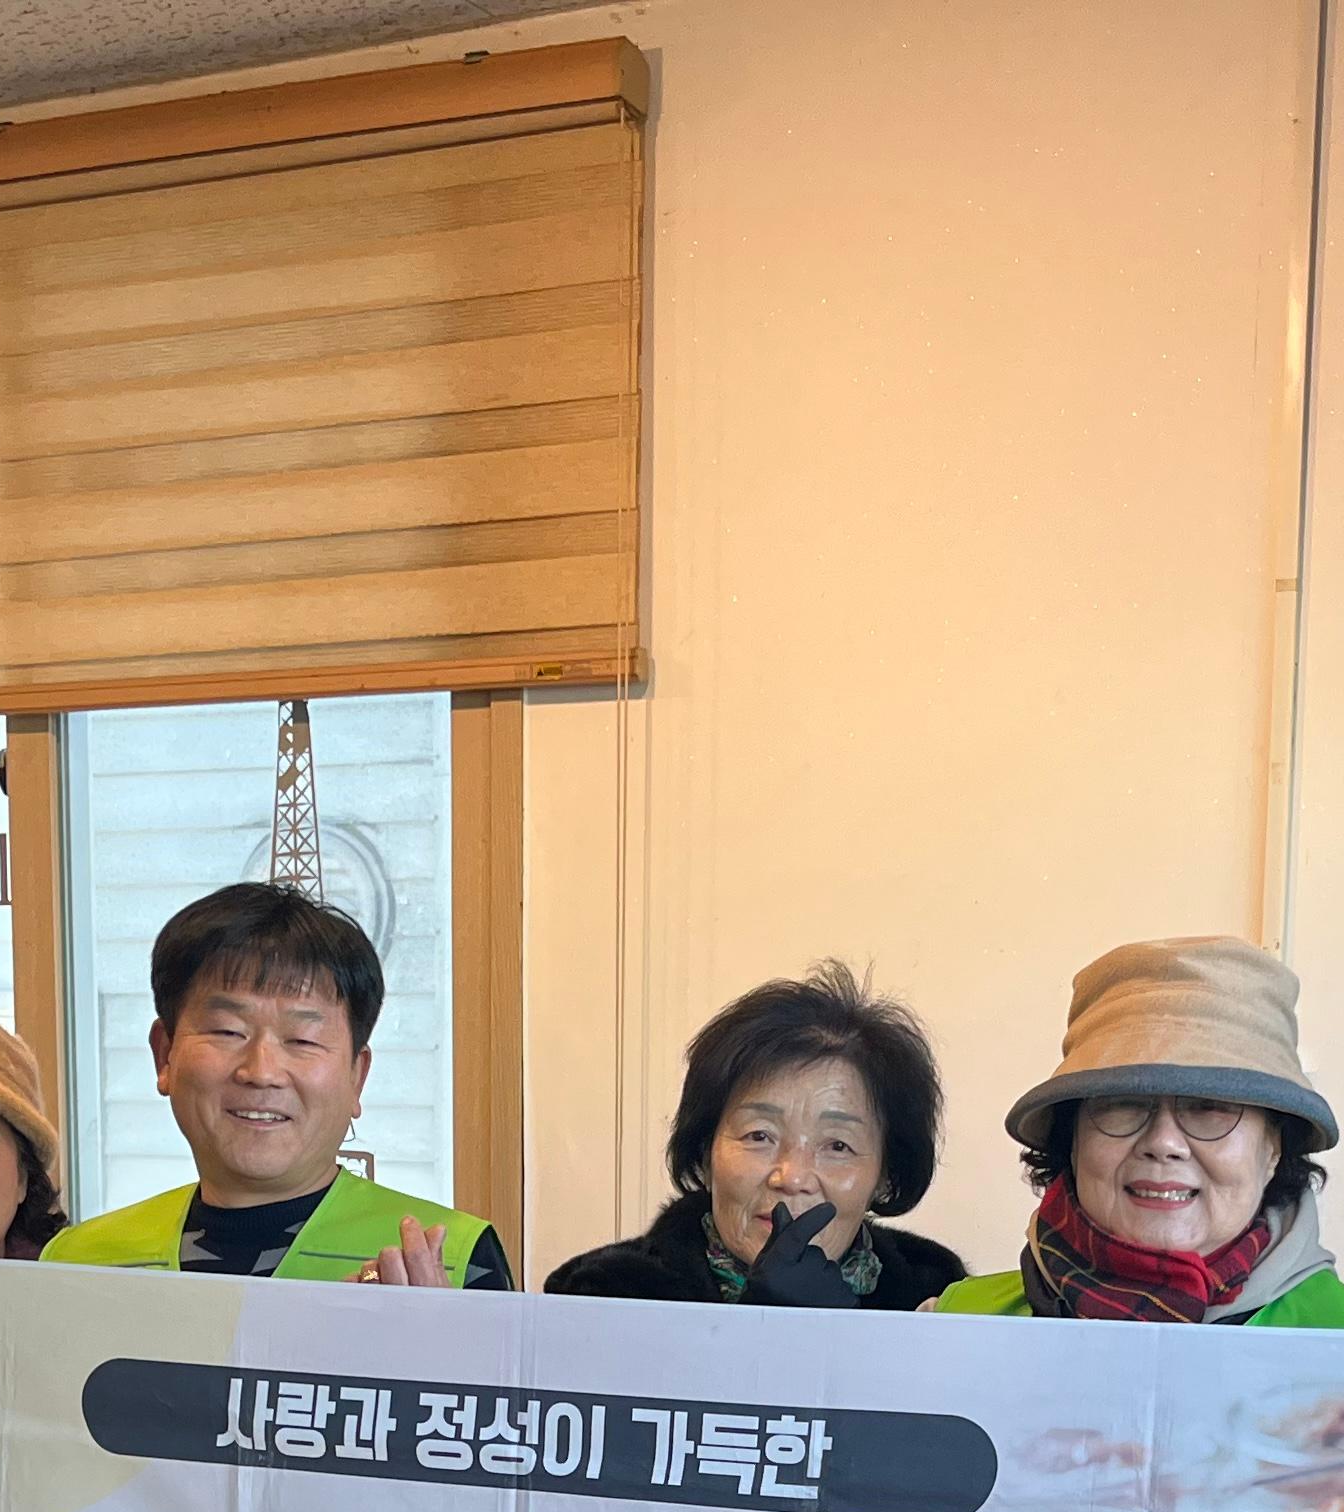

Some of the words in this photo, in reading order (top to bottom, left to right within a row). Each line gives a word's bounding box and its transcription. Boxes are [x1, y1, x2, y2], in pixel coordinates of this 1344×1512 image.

[216, 1377, 397, 1462] 사랑과
[416, 1391, 606, 1480] 정성이
[631, 1407, 833, 1500] 가득한
